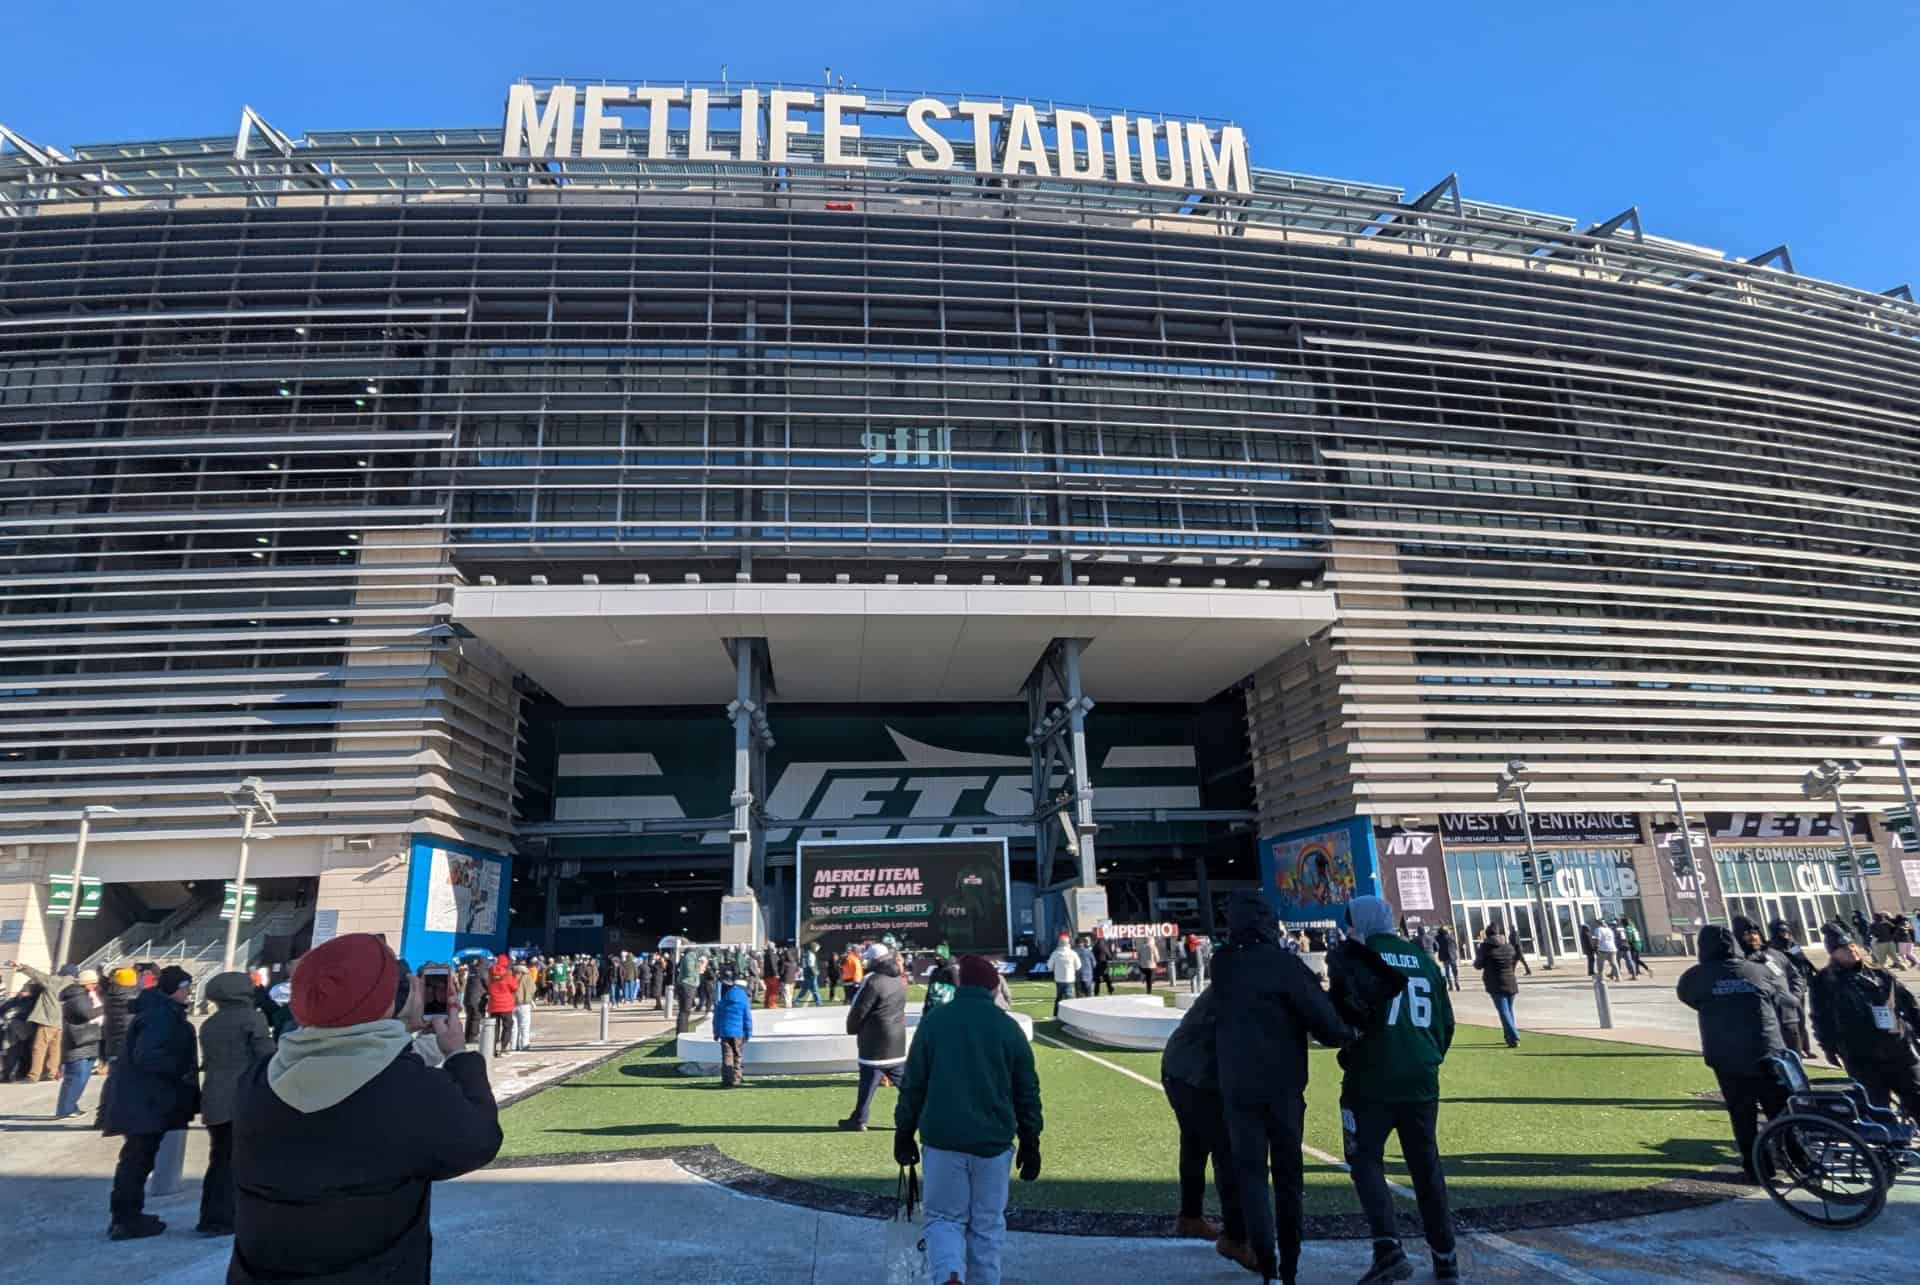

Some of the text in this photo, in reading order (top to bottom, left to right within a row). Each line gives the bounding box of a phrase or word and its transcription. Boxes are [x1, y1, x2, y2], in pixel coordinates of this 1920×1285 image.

[502, 84, 1253, 195] METLIFE STADIUM
[1443, 812, 1635, 831] WEST VIP ENTRANCE
[1386, 836, 1432, 855] NY
[1757, 849, 1838, 861] COMMISSION
[815, 867, 920, 883] MERCH ITEM
[1556, 867, 1640, 897] CLUB
[1796, 864, 1858, 892] CLU
[812, 882, 924, 898] OF THE GAME
[831, 906, 850, 914] OFF
[852, 905, 882, 914] GREEN
[884, 903, 927, 913] T-SHIRTS
[810, 923, 844, 931] Available
[872, 921, 890, 931] Shop
[893, 920, 929, 929] Locations
[1381, 952, 1420, 968] HOLDER
